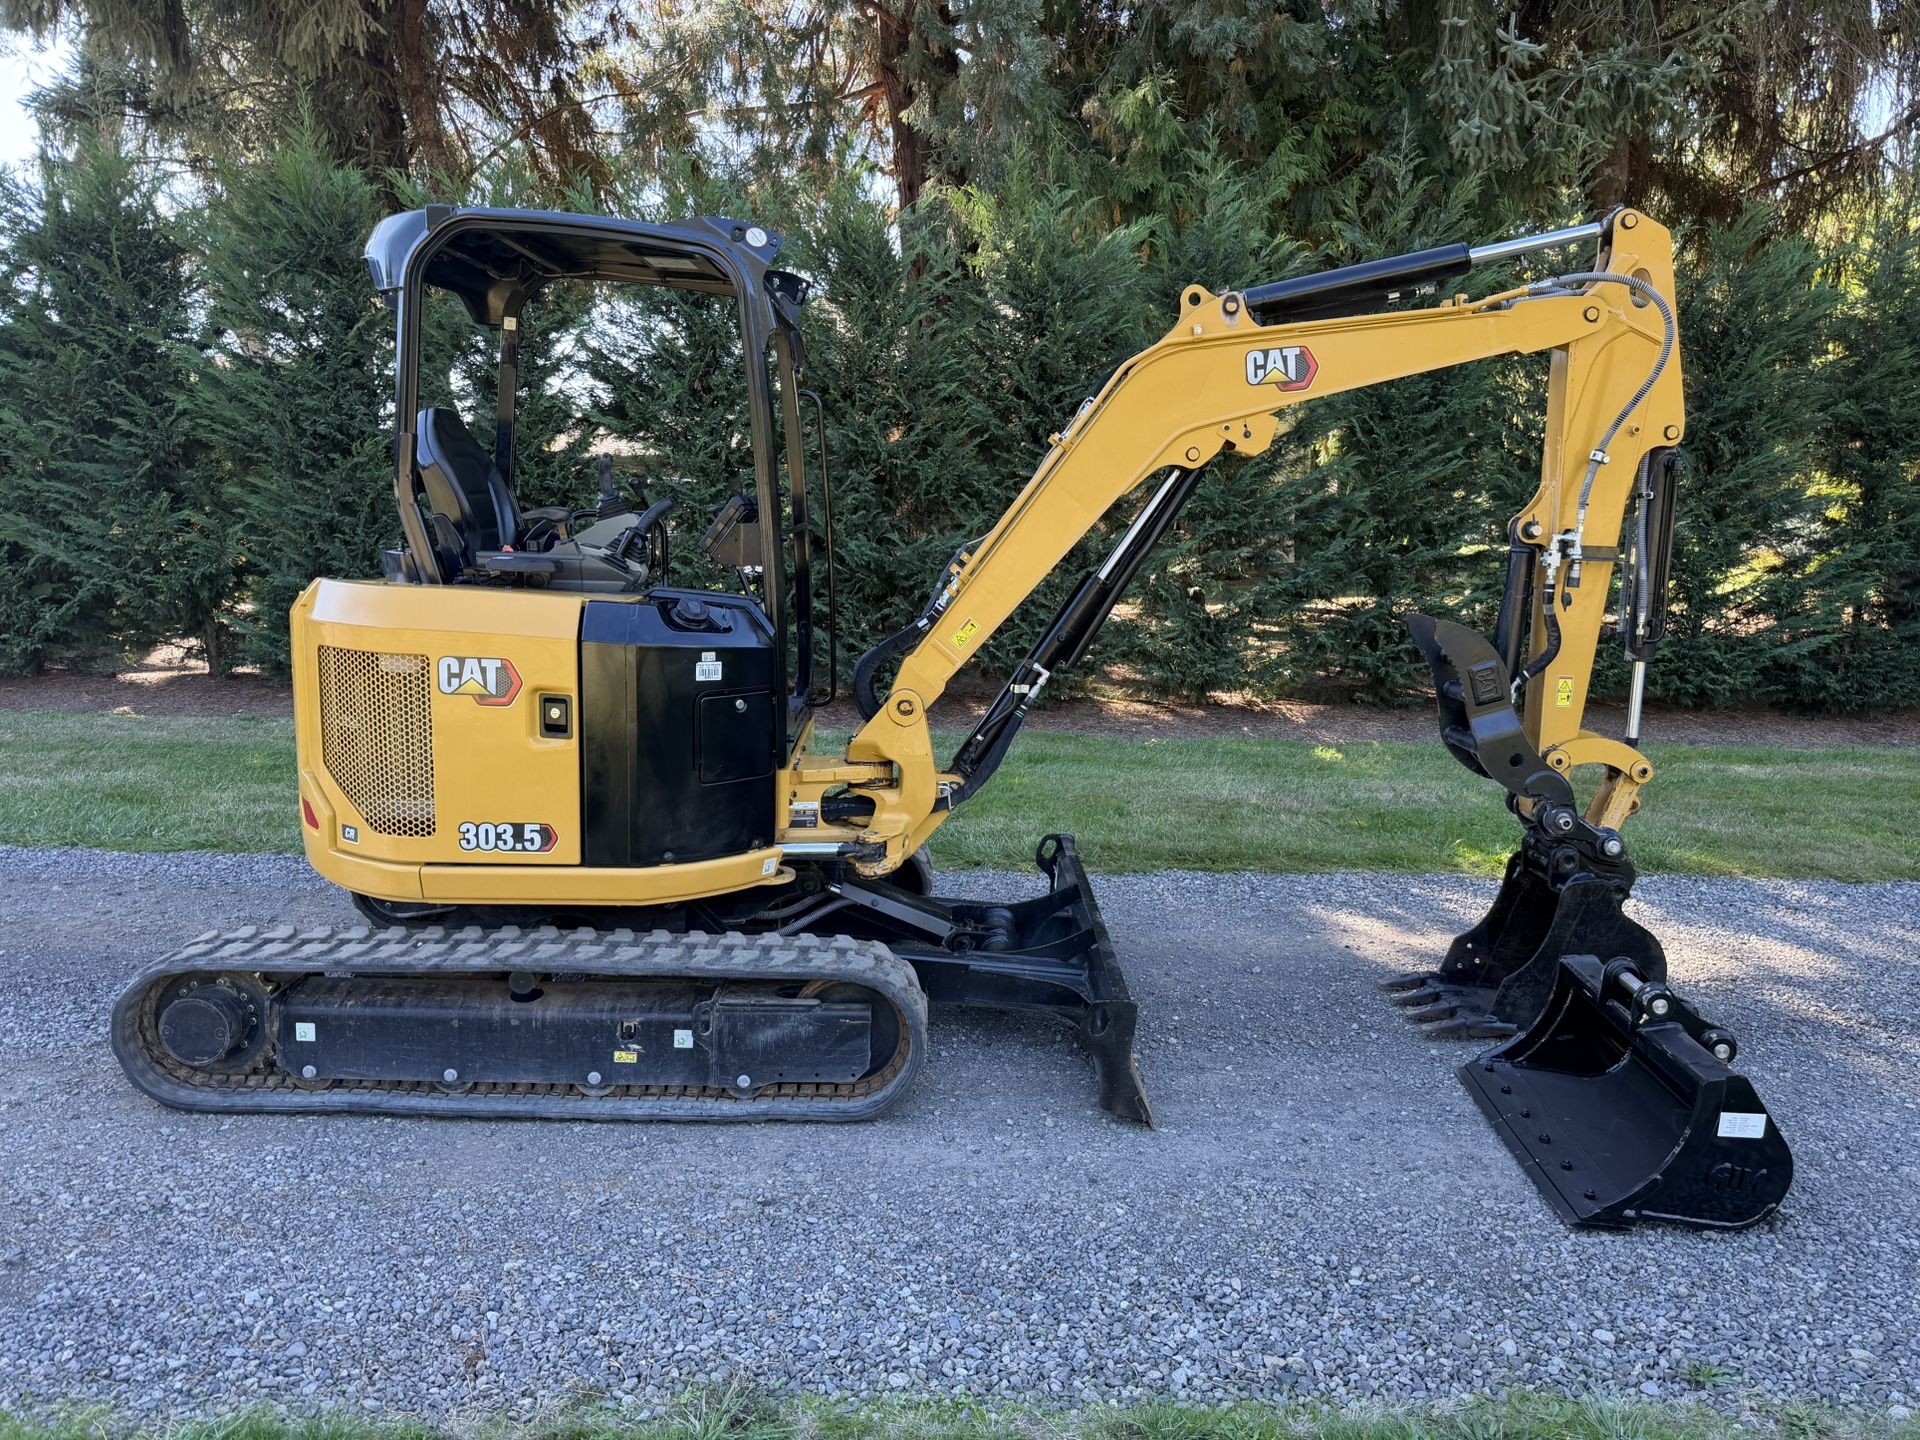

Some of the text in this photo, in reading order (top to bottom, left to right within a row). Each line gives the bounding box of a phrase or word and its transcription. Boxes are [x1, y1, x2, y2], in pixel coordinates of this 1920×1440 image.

[1246, 347, 1300, 385] CAT
[439, 657, 501, 695] CAT
[1475, 667, 1499, 699] CAT
[345, 828, 355, 839] CR
[459, 823, 541, 851] 303.5
